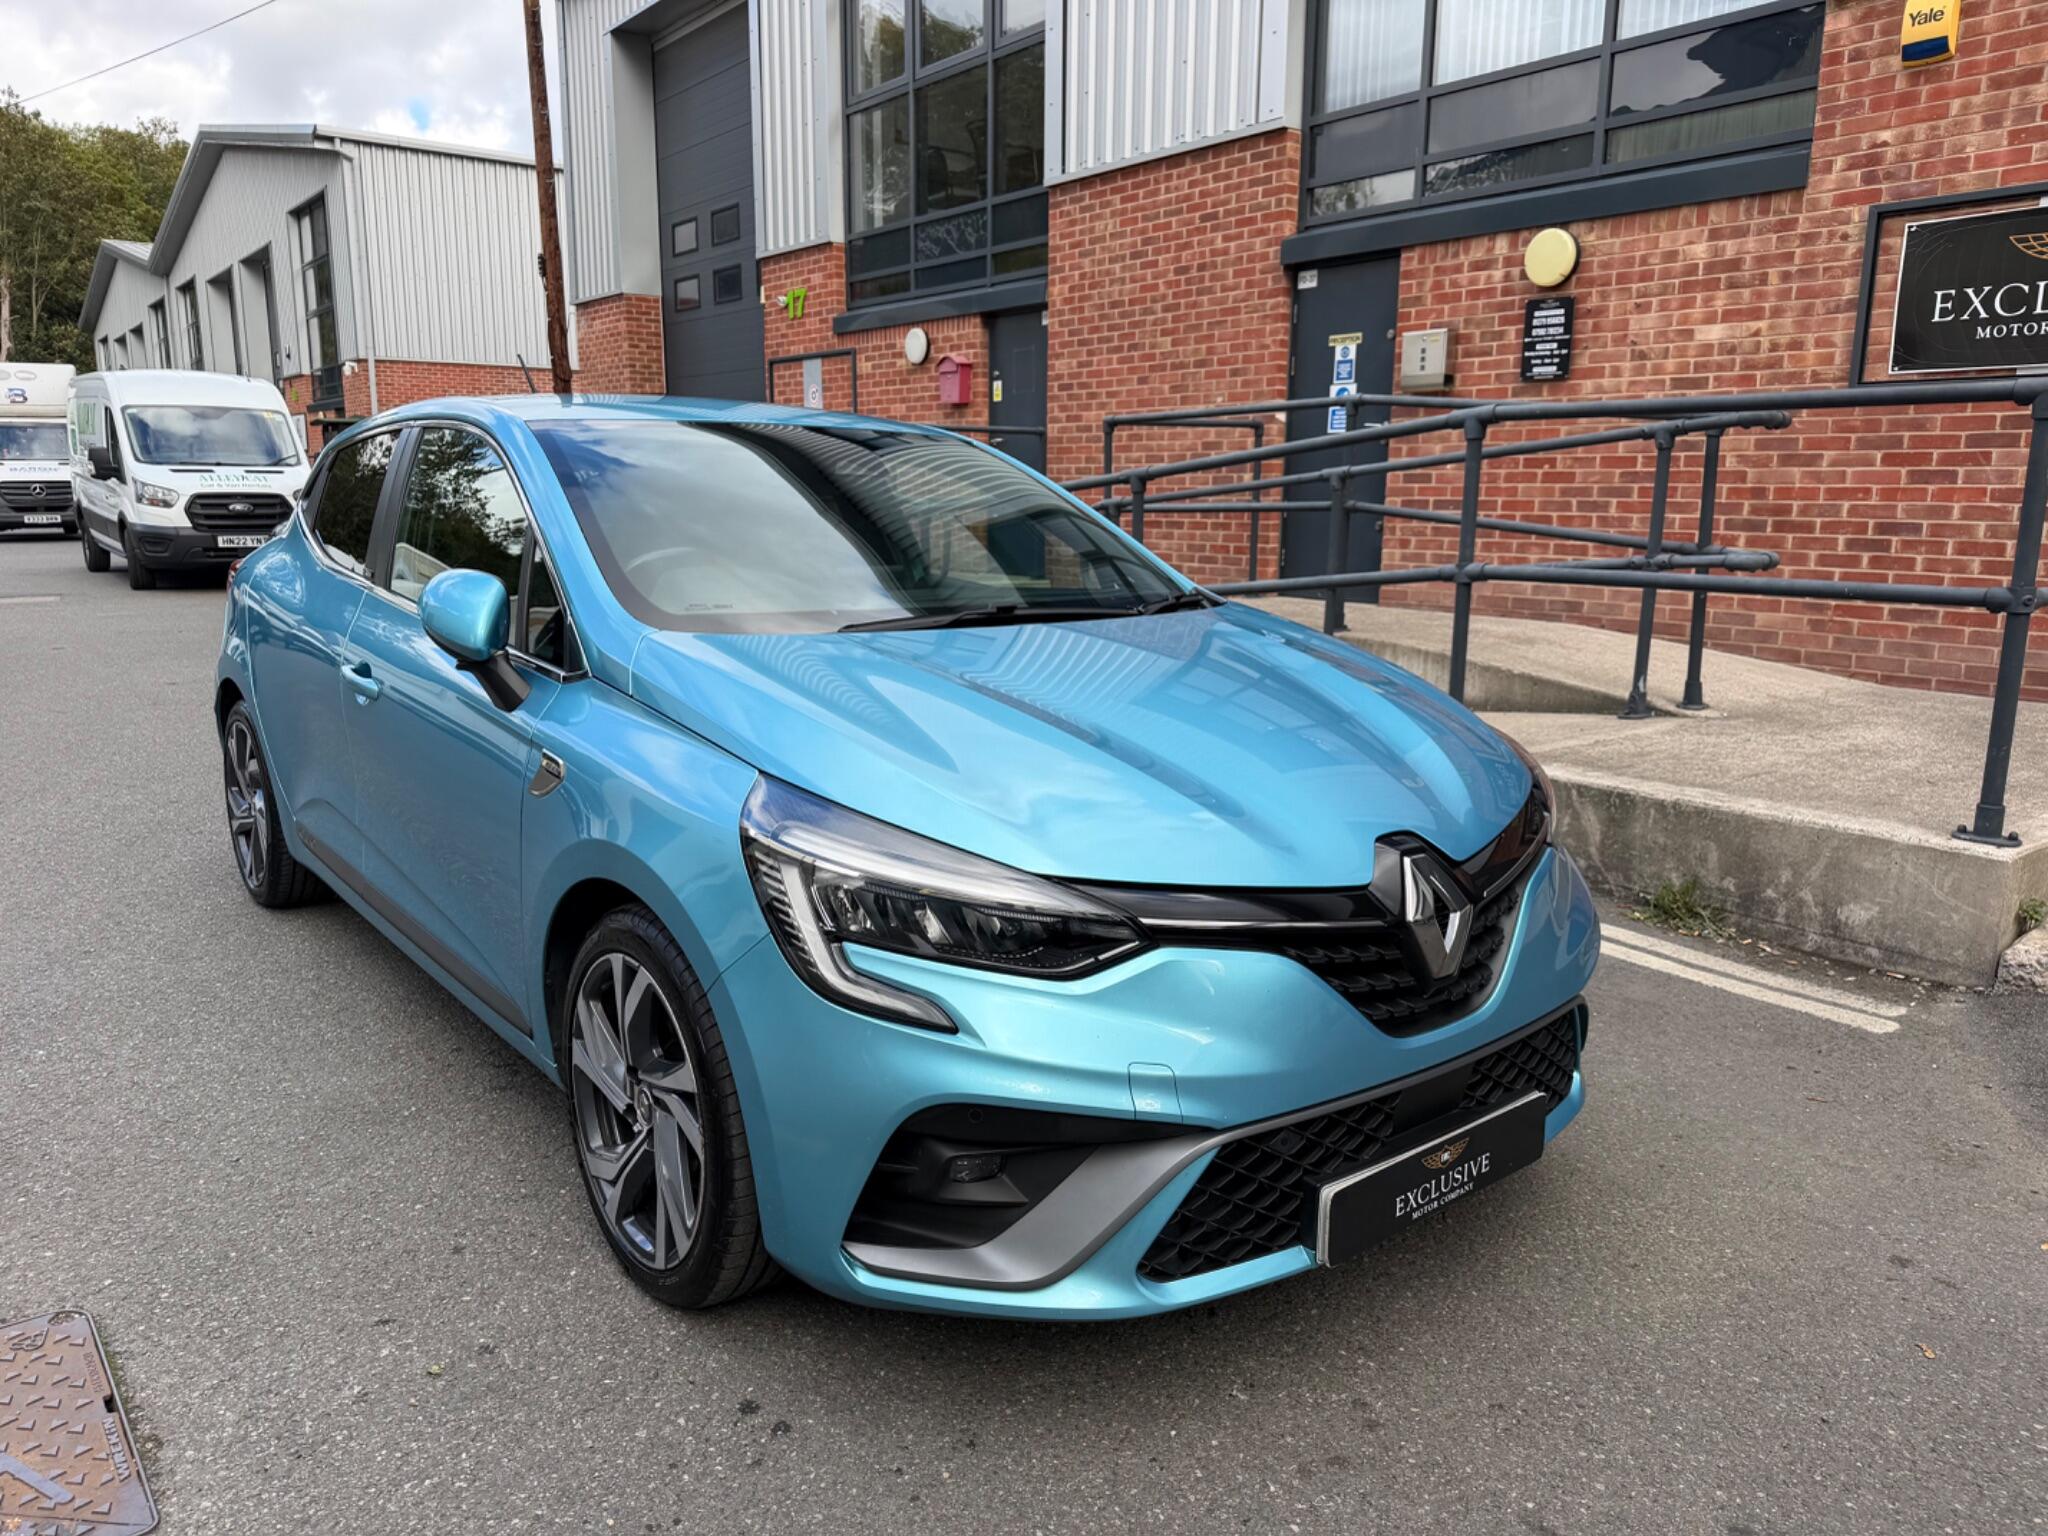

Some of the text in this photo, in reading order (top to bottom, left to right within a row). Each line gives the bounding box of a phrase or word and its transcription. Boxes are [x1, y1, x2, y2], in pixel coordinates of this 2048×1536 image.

[1909, 7, 1945, 27] Yale
[786, 287, 807, 320] 17
[1931, 280, 2048, 322] EXCL
[1395, 1152, 1490, 1217] EXCLUSIVE
[1412, 1182, 1474, 1220] MOTOR COMPANY
